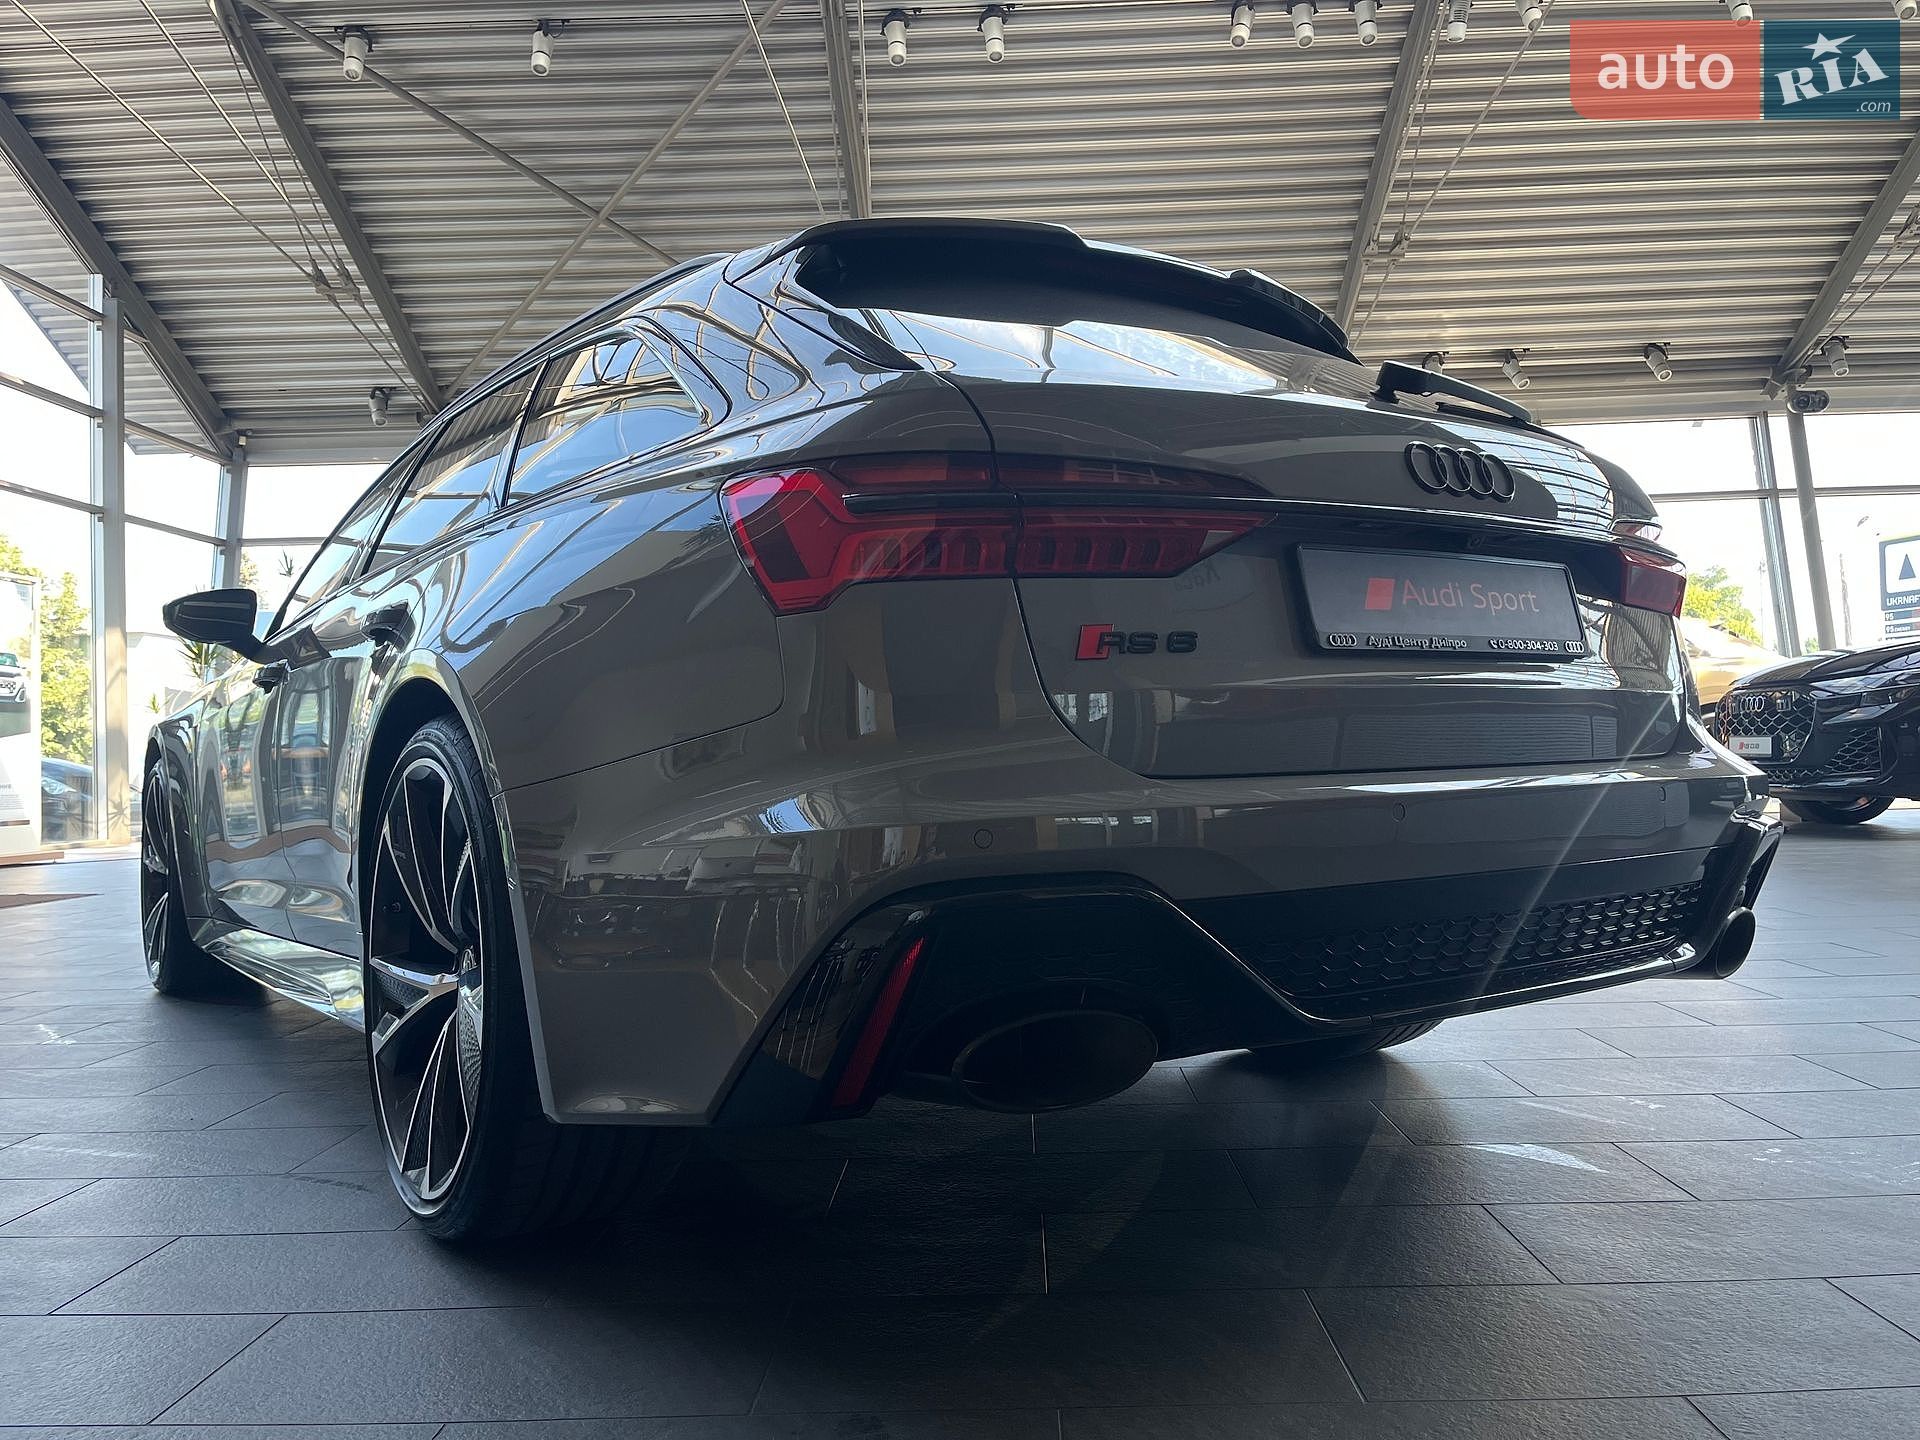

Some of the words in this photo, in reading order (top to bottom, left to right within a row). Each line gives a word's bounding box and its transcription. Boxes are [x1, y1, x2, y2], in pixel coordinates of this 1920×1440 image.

[1402, 579, 1464, 608] Audi
[1469, 583, 1540, 616] Sport
[1886, 594, 1920, 606] UKRNAF
[1096, 631, 1159, 655] RS
[1166, 631, 1199, 654] 6
[1368, 635, 1393, 648] Ауді
[1394, 636, 1429, 649] Центр
[1431, 636, 1467, 650] Дніпро
[1498, 639, 1559, 652] 0-800-304-303
